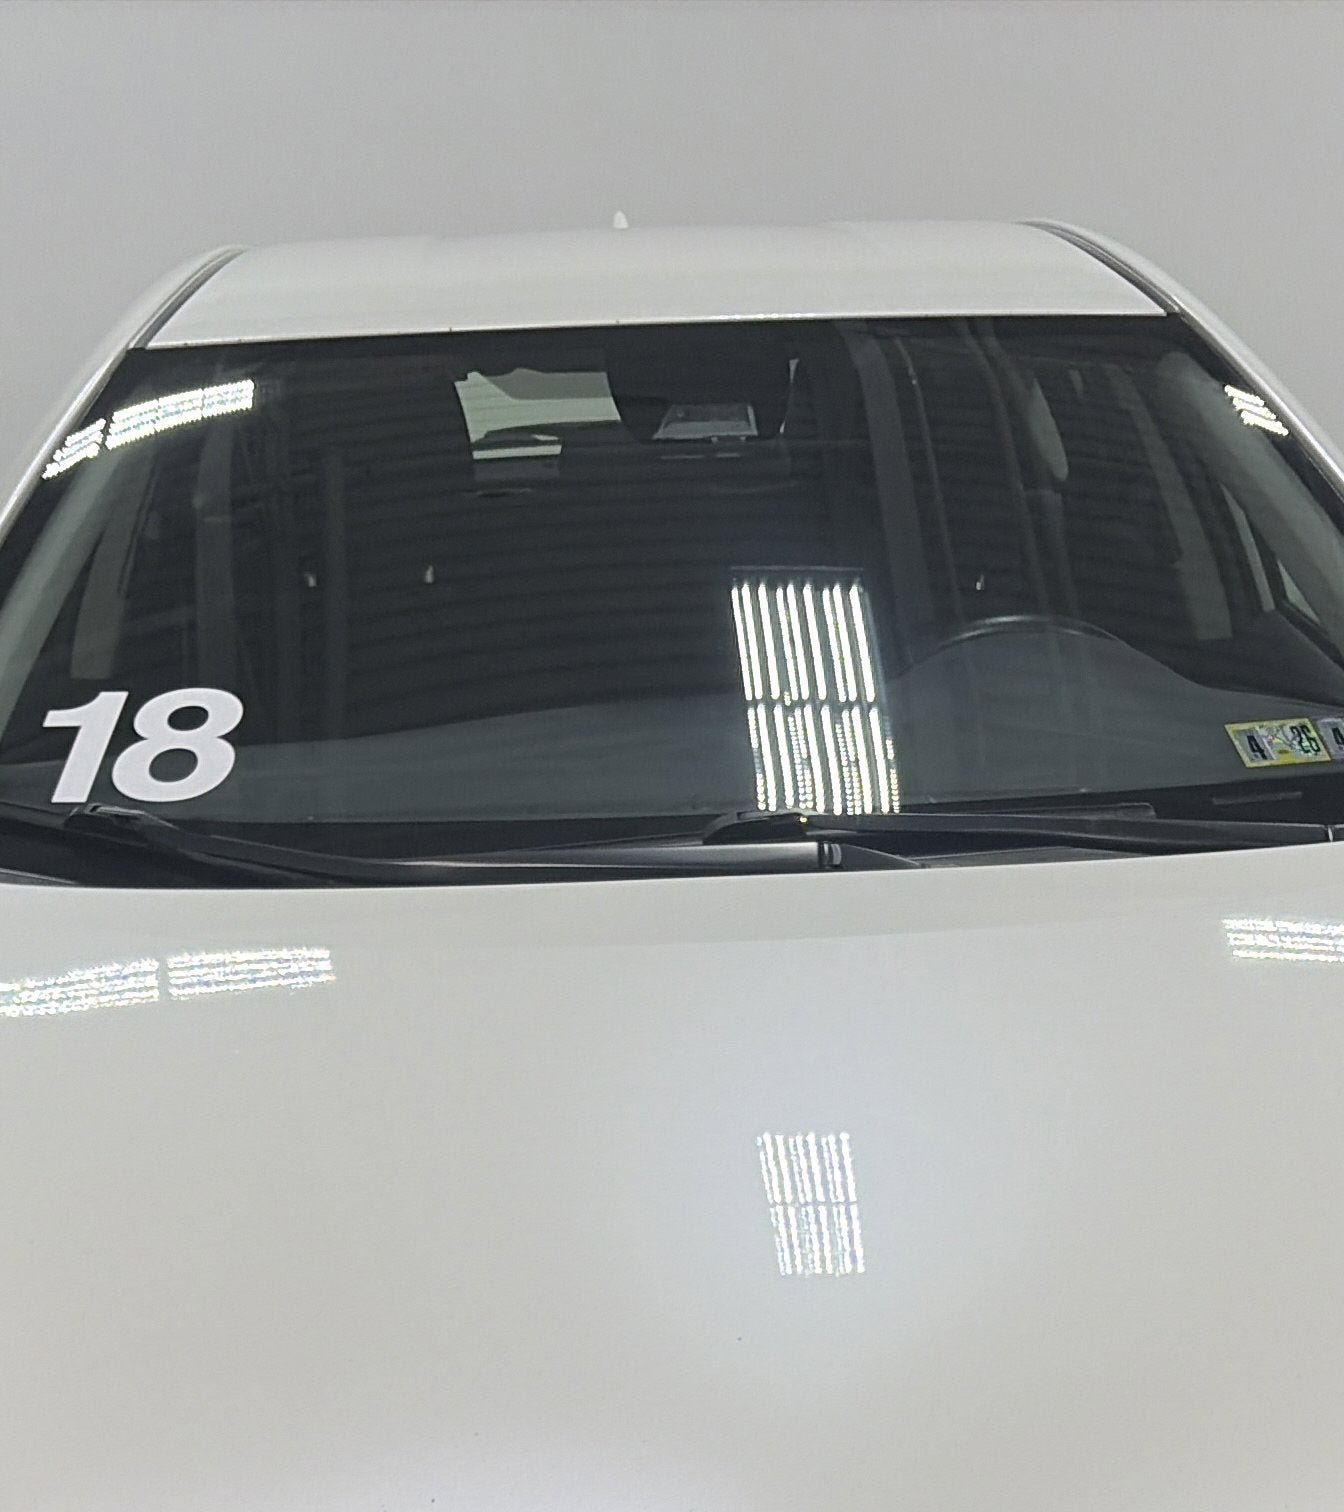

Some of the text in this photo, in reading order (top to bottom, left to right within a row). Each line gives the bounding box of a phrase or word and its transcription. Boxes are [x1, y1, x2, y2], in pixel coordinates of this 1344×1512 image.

[43, 687, 244, 803] 18
[1246, 725, 1321, 759] 4 26
